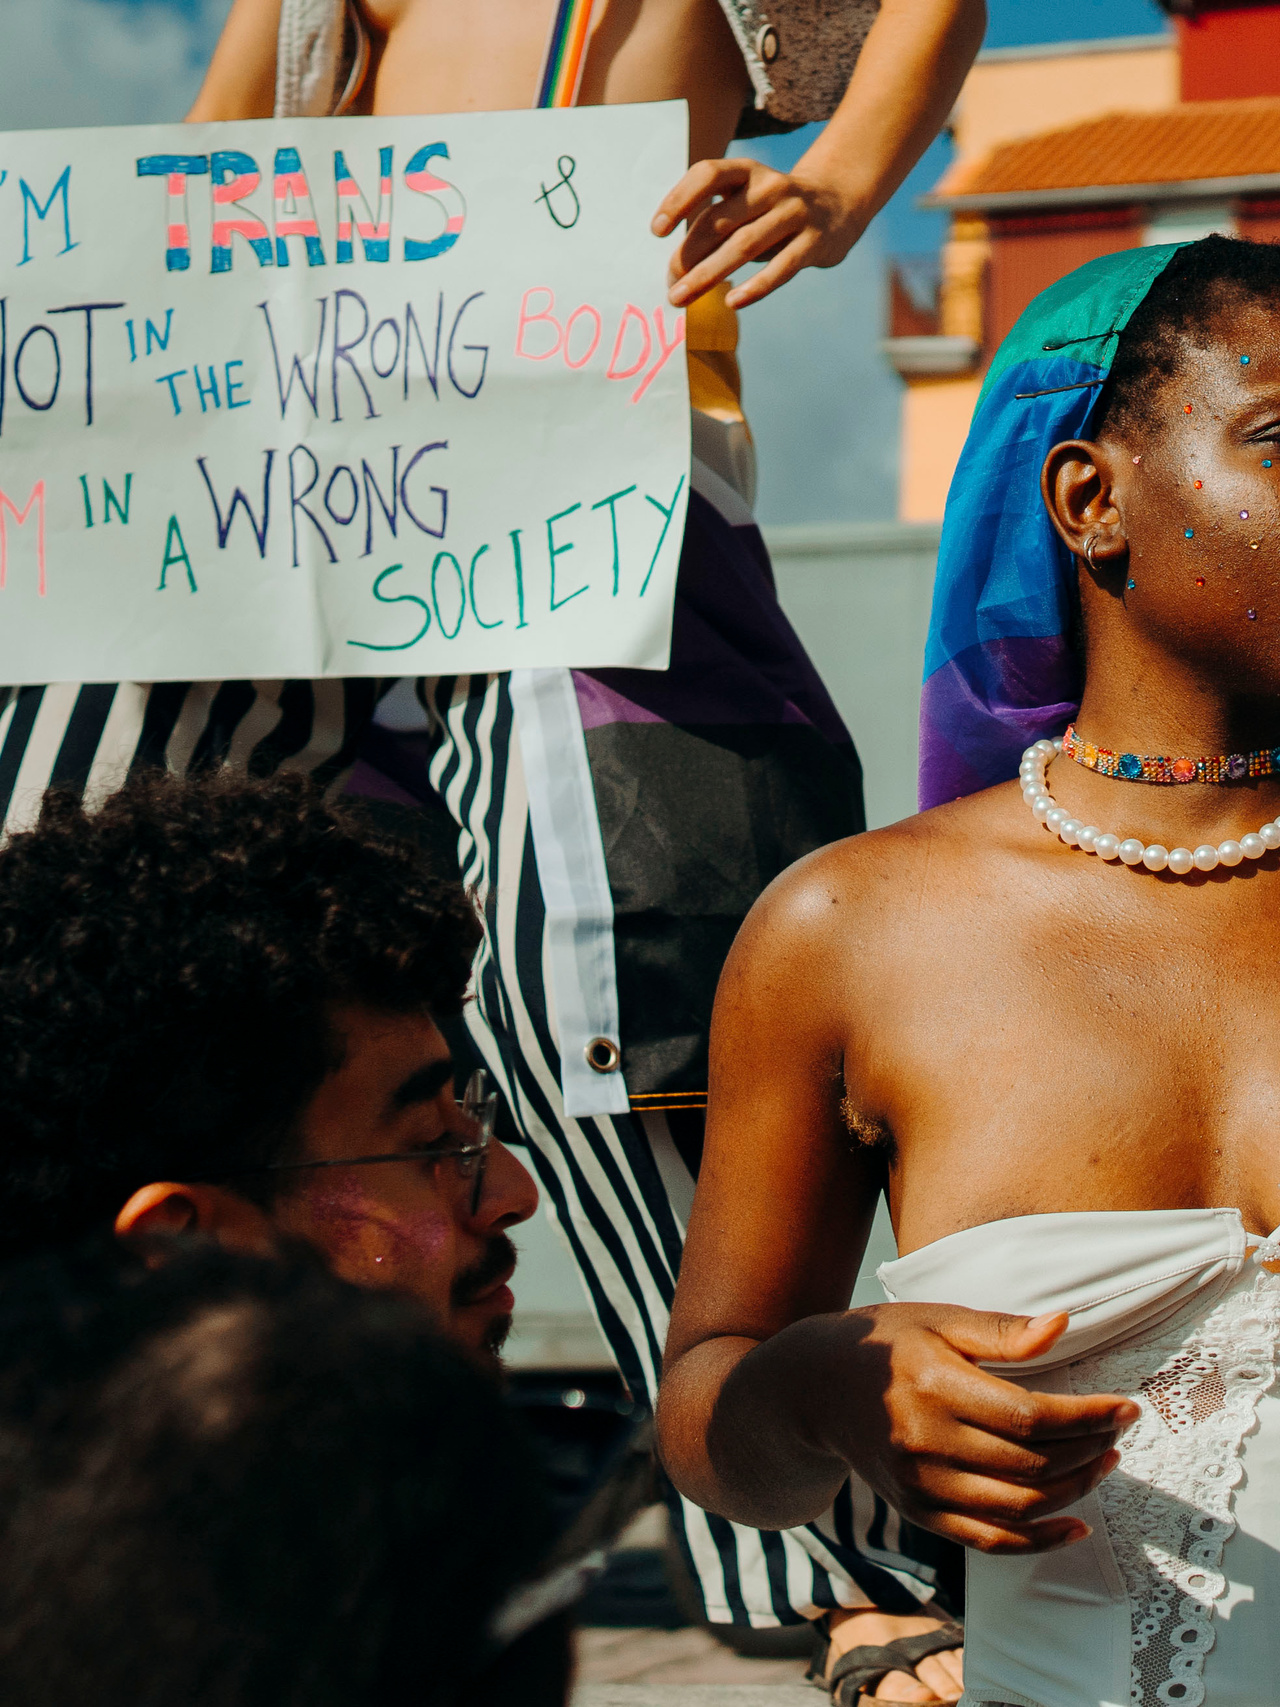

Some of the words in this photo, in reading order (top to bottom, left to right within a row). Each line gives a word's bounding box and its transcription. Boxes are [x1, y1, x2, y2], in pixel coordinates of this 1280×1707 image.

[136, 141, 467, 274] TRANS
[534, 155, 580, 229] &
[0, 296, 127, 437] OT
[125, 308, 174, 363] IN
[155, 359, 251, 416] THE
[256, 289, 489, 422] WRONG
[515, 286, 685, 404] BODY
[79, 472, 134, 529] IN
[155, 514, 199, 593] A
[196, 441, 449, 568] WRONG
[347, 474, 686, 651] SOCIETY
